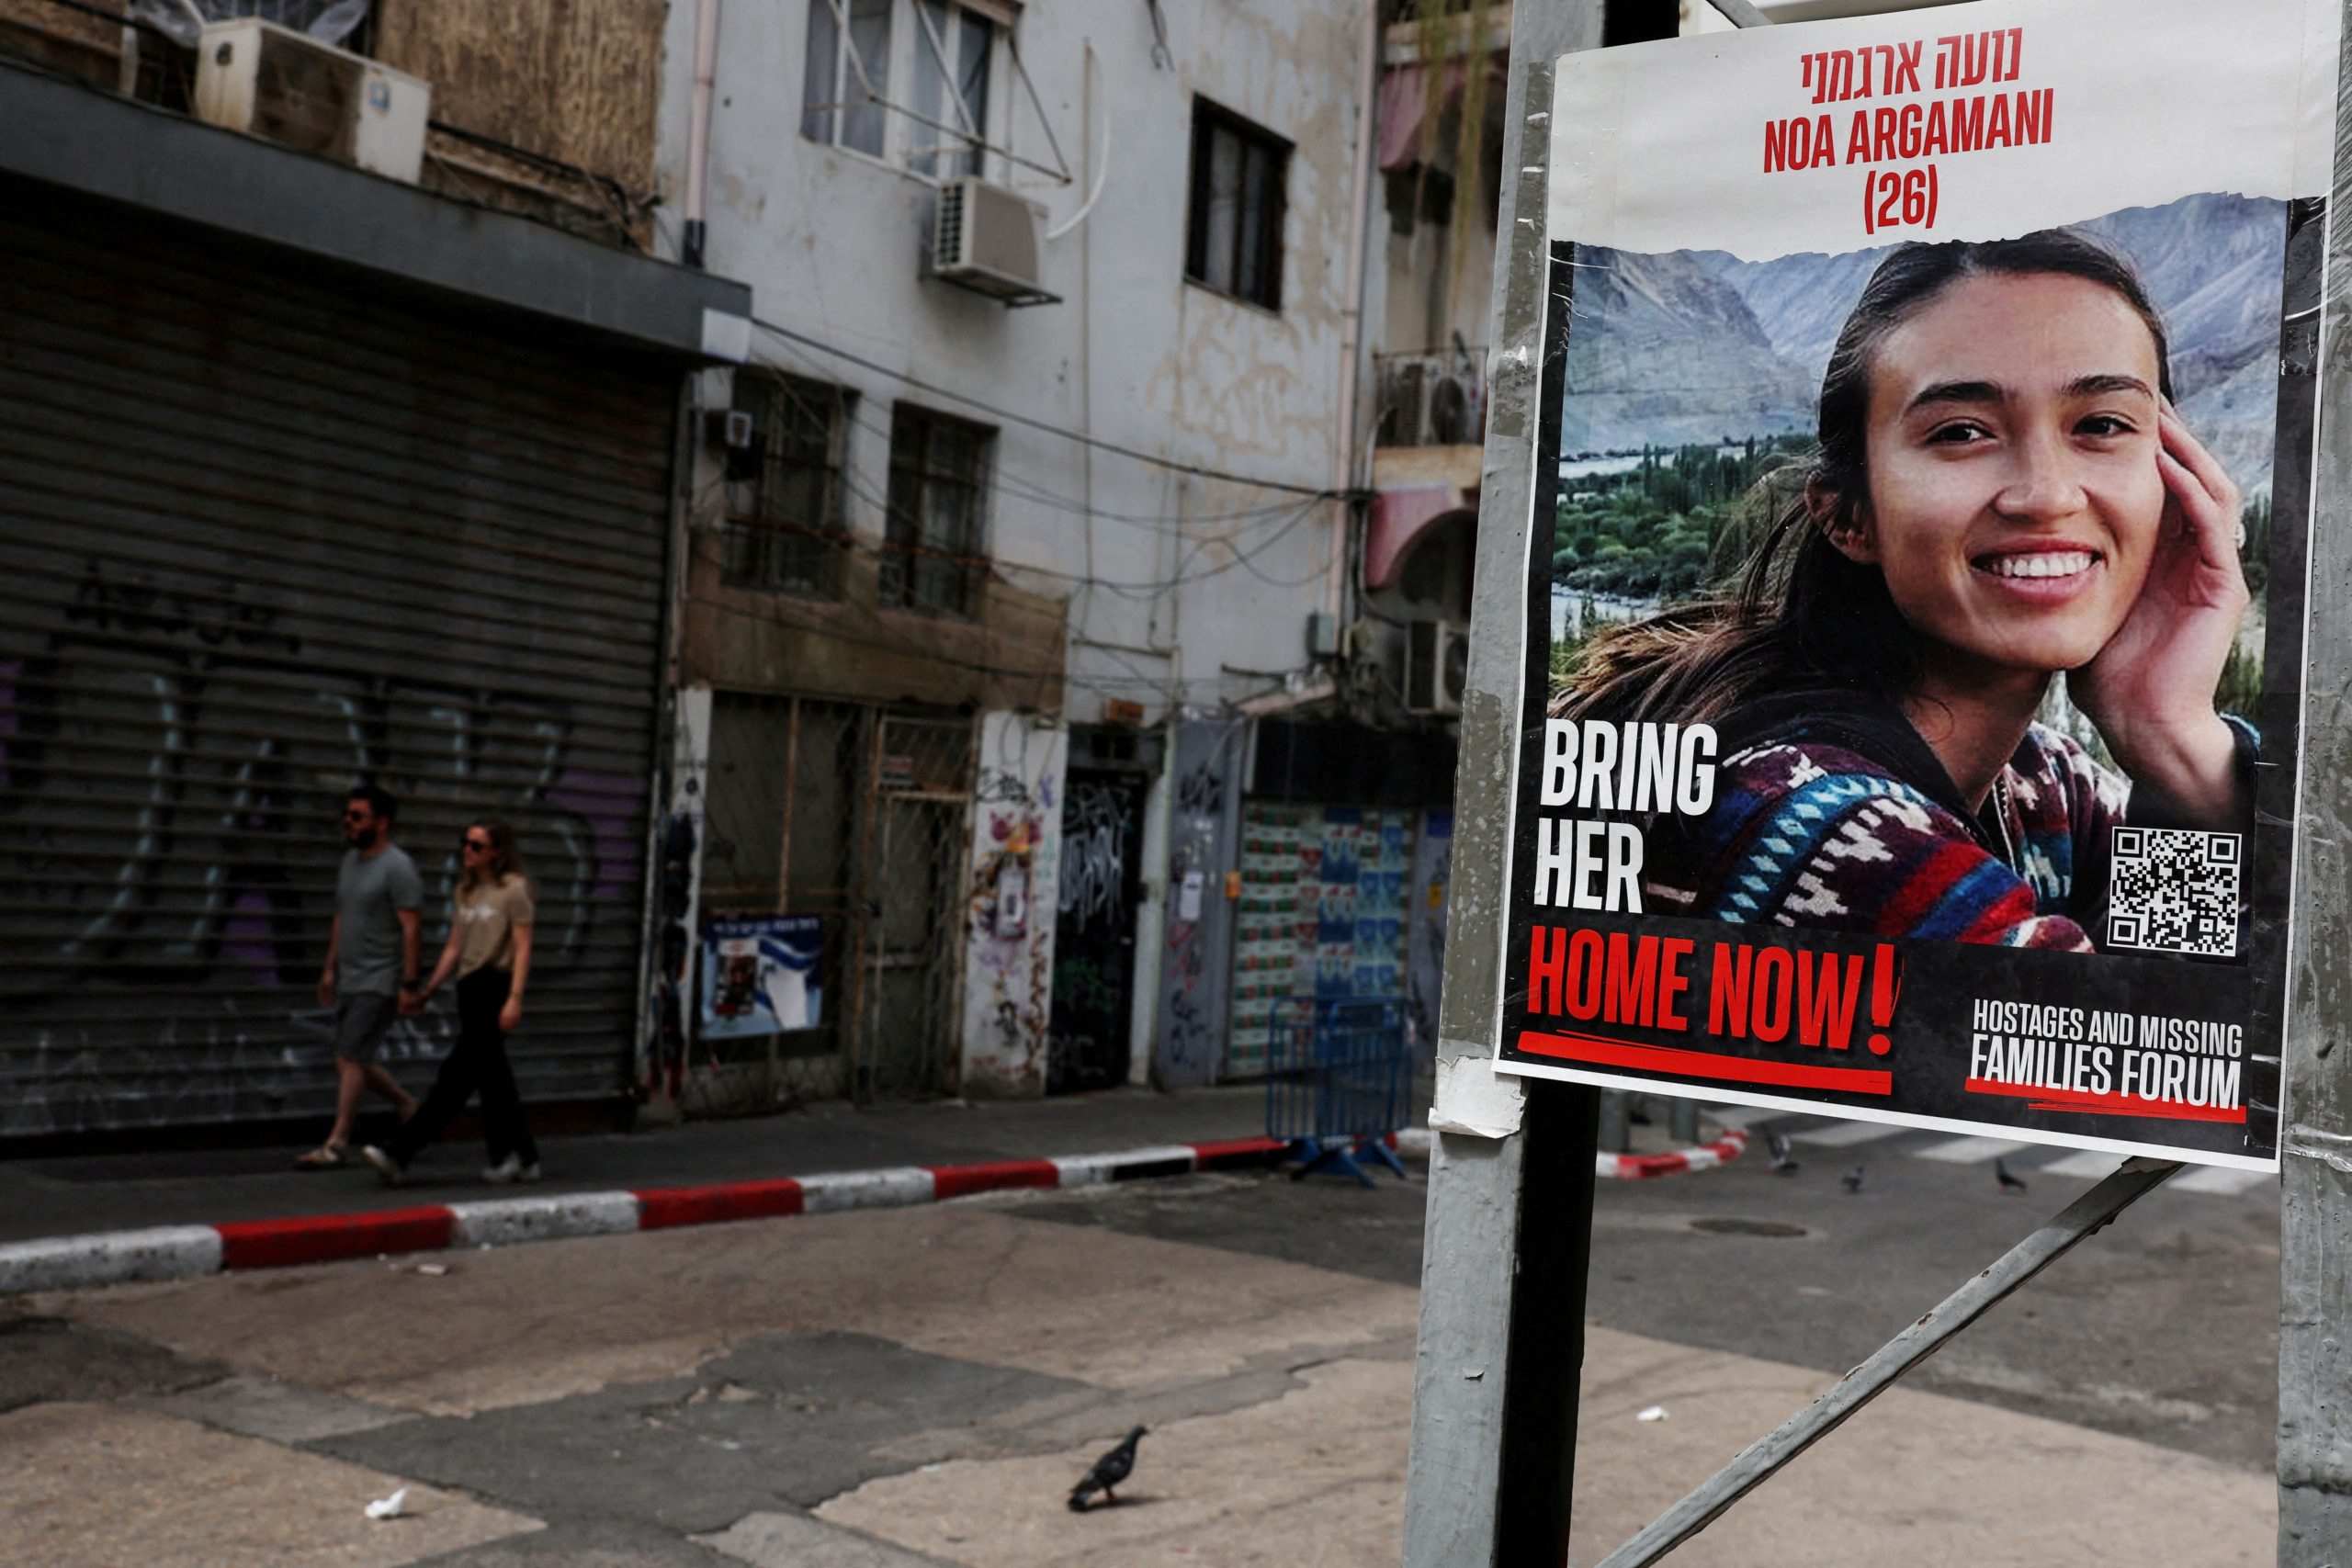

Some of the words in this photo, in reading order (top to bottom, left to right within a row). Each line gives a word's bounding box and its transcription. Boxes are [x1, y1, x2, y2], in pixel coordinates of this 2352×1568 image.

[1801, 40, 1923, 104] ארגמני
[1935, 28, 2022, 89] נועה
[1764, 115, 1835, 173] NOA
[1846, 88, 2053, 164] ARGAMANI
[1864, 164, 1938, 234] (26)
[1540, 718, 1718, 816] BRING
[1534, 818, 1644, 914] HER
[1527, 925, 1694, 1032] HOME
[1708, 942, 1898, 1055] NOW!
[1973, 998, 2084, 1042] HOSTAGES
[2088, 1010, 2134, 1046] AND
[2139, 1015, 2242, 1057] MISSING
[1970, 1032, 2113, 1096] FAMILIES
[2120, 1049, 2242, 1111] FORUM
